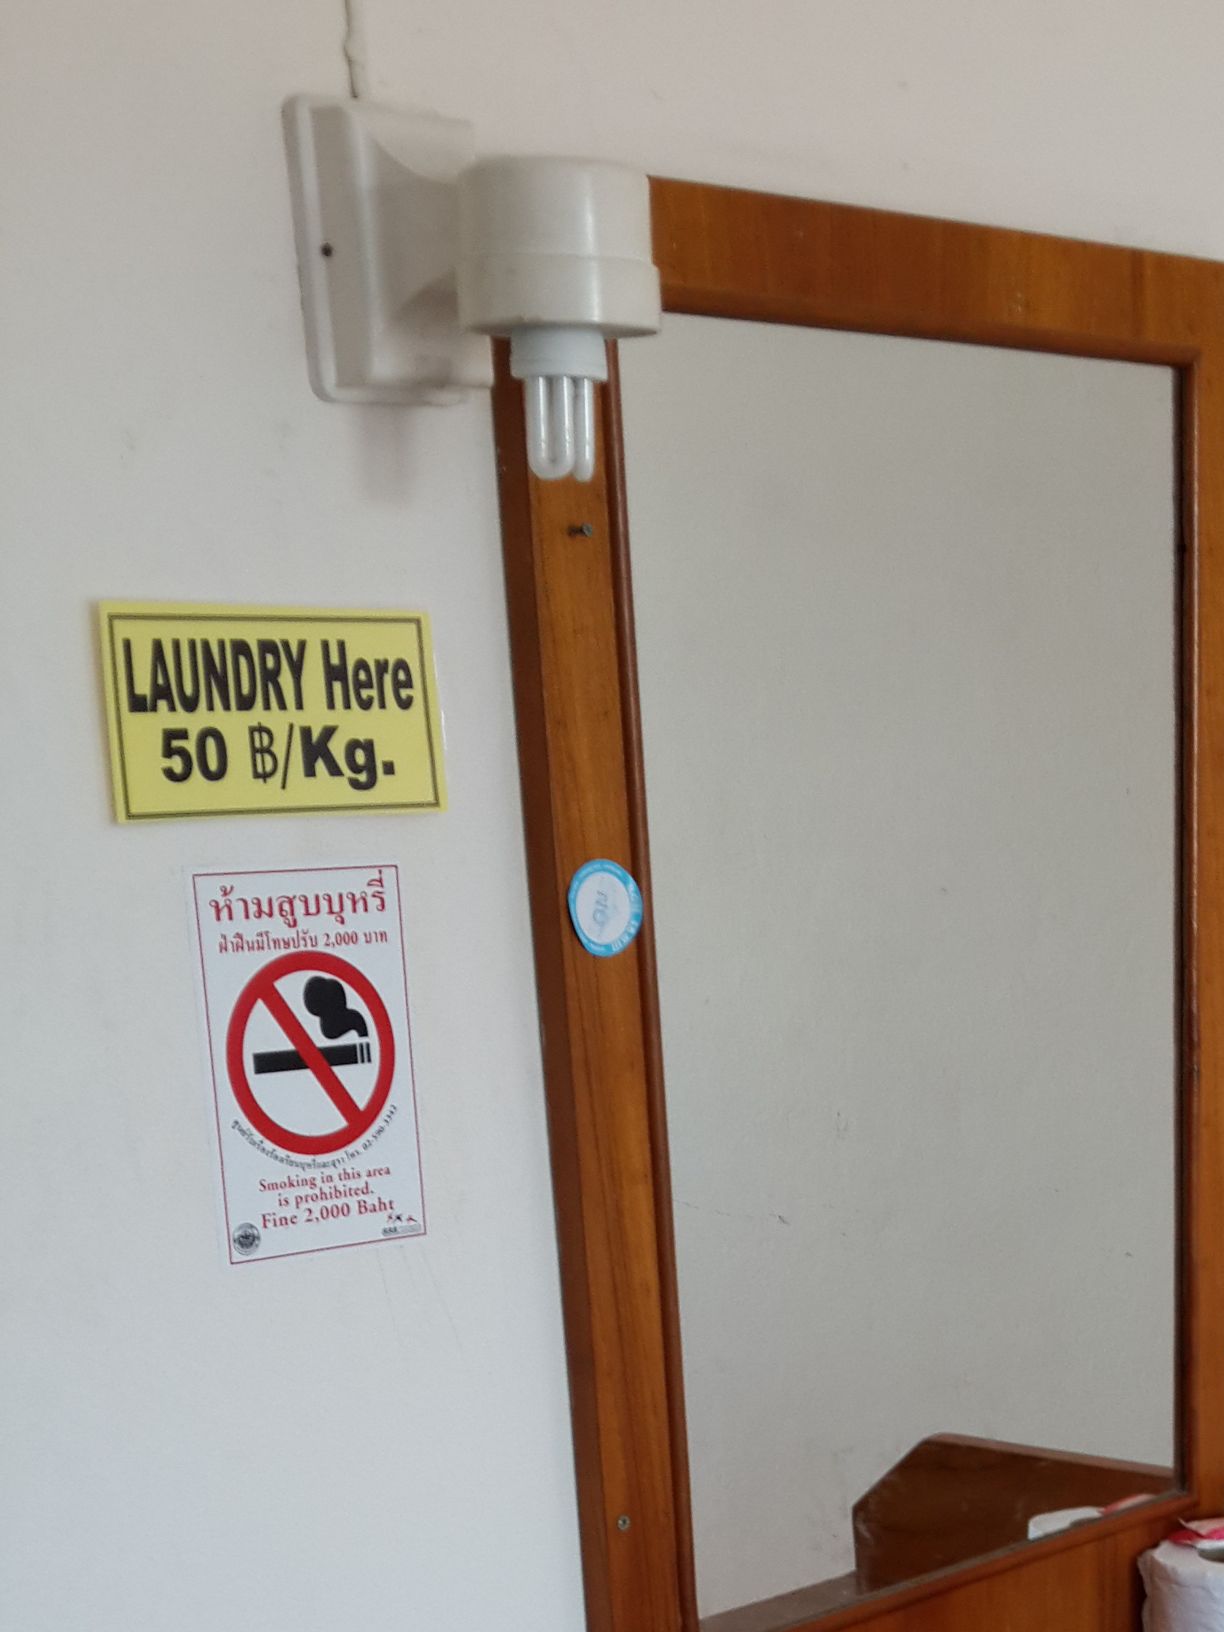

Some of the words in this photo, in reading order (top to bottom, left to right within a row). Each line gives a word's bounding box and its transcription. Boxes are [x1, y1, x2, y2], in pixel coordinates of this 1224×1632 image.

[122, 637, 307, 713] LAUNDRY
[320, 638, 414, 712] Here
[160, 725, 228, 783] 50
[208, 869, 387, 929] ห้ามสูบบุหรี่
[322, 930, 359, 948] 2,000
[364, 929, 389, 944] บาท
[258, 1174, 318, 1193] Smoking
[321, 1171, 334, 1184] in
[338, 1167, 361, 1181] this
[366, 1166, 391, 1179] area
[278, 1193, 289, 1208] is
[294, 1181, 375, 1210] prohibited.
[260, 1212, 298, 1230] Fine
[304, 1202, 351, 1223] 2,000
[357, 1196, 396, 1216] Baht
